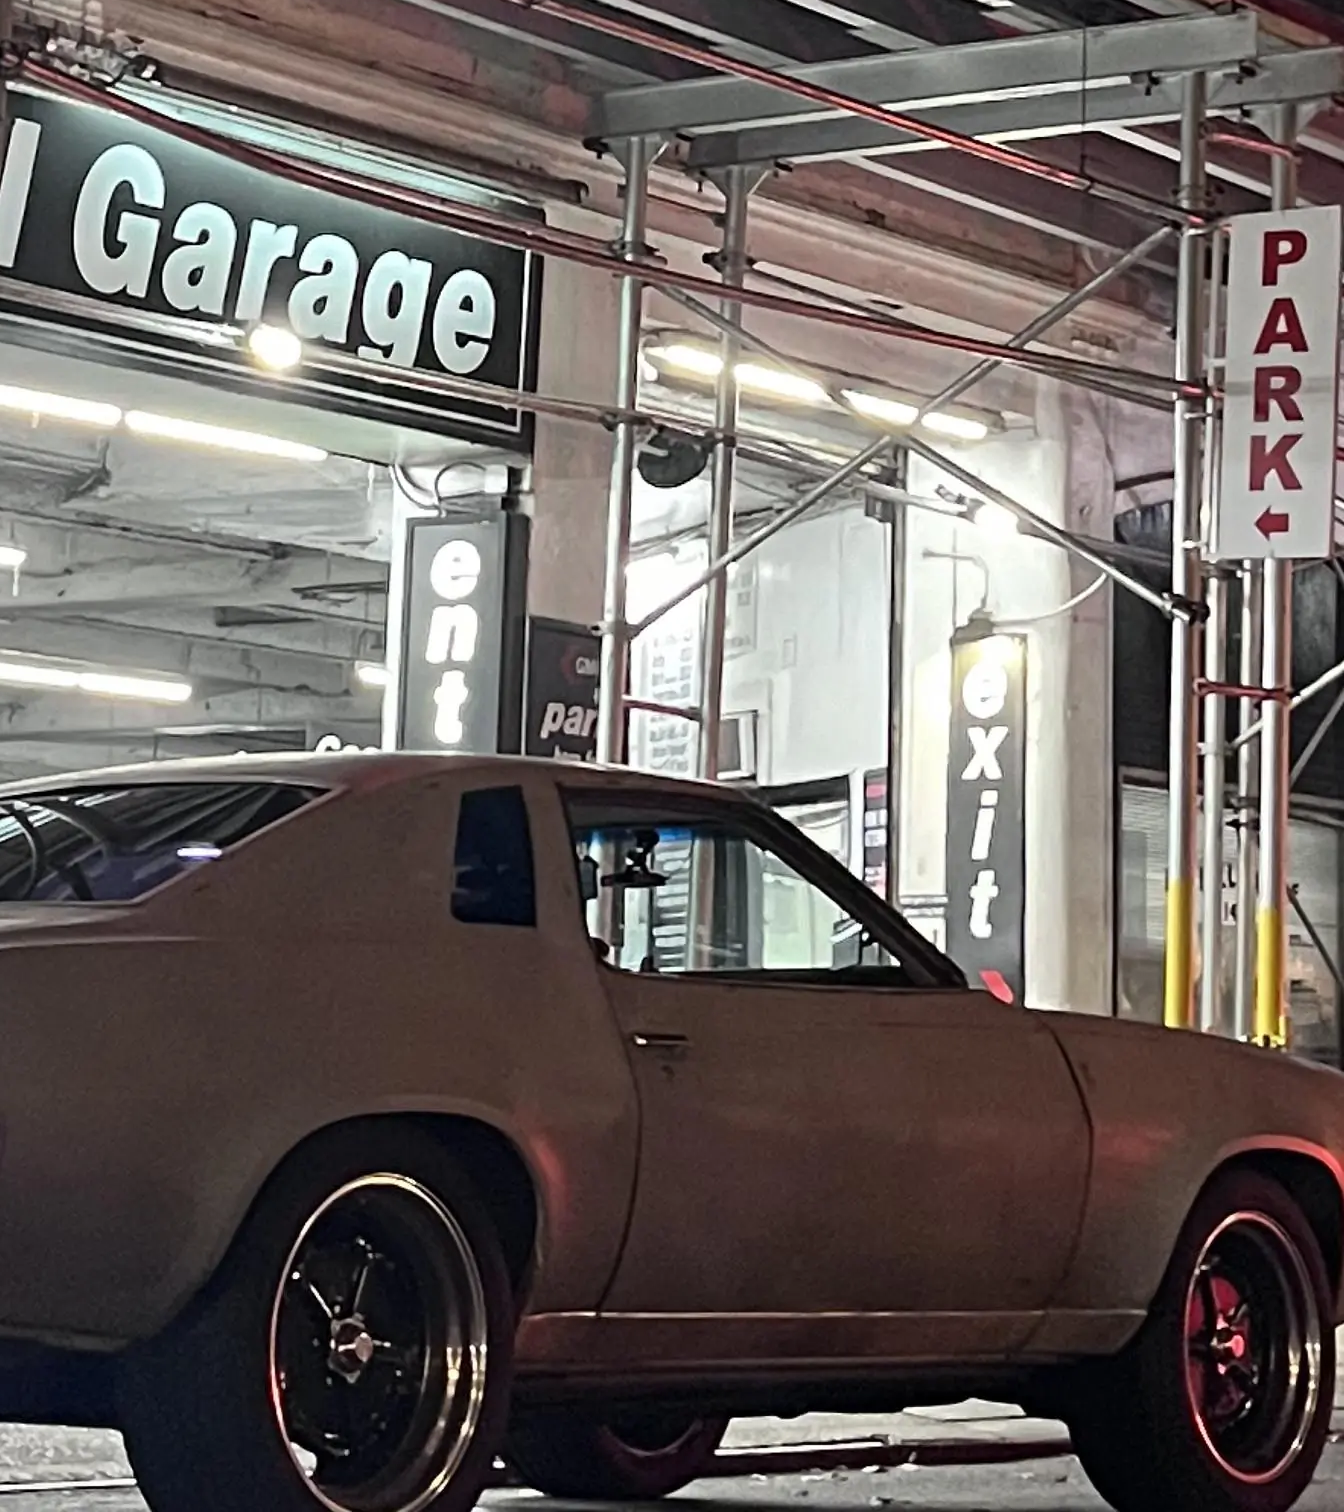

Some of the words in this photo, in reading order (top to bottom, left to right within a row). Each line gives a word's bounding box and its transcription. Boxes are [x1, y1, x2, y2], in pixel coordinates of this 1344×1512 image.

[73, 143, 497, 374] Garage
[1248, 230, 1310, 492] PARK
[962, 657, 1010, 940] exit
